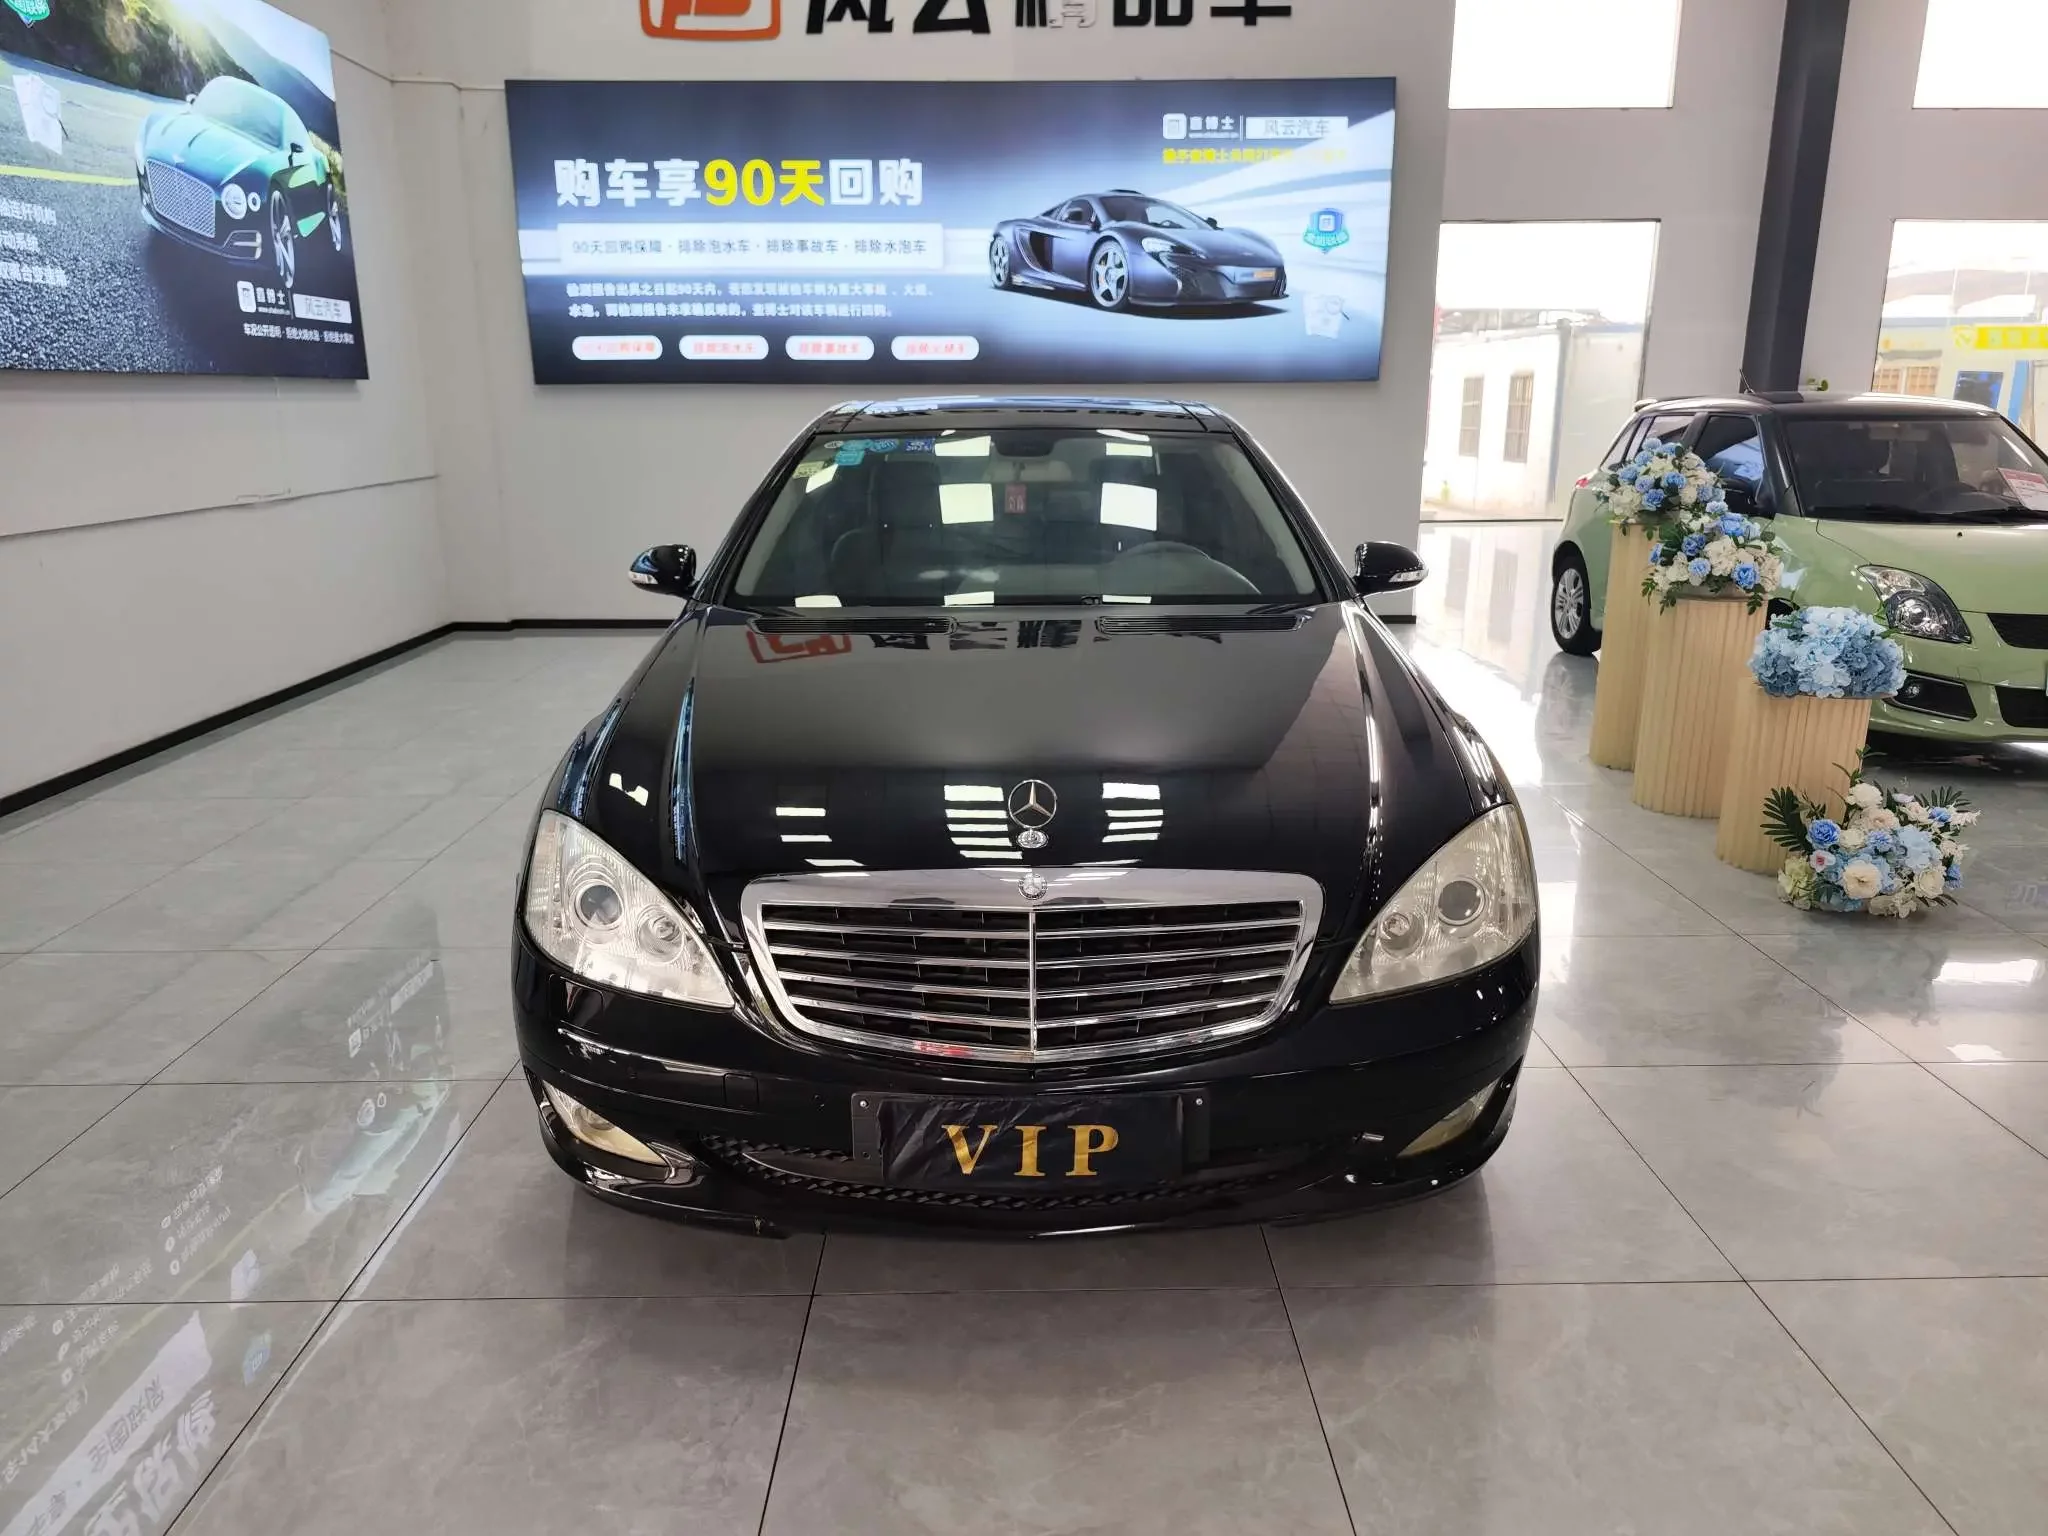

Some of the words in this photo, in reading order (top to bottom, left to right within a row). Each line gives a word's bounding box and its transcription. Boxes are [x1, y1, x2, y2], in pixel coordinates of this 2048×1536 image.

[1264, 119, 1330, 137] 风云汽车
[554, 158, 924, 208] 购车享90天回购
[941, 1123, 1120, 1177] VIP
